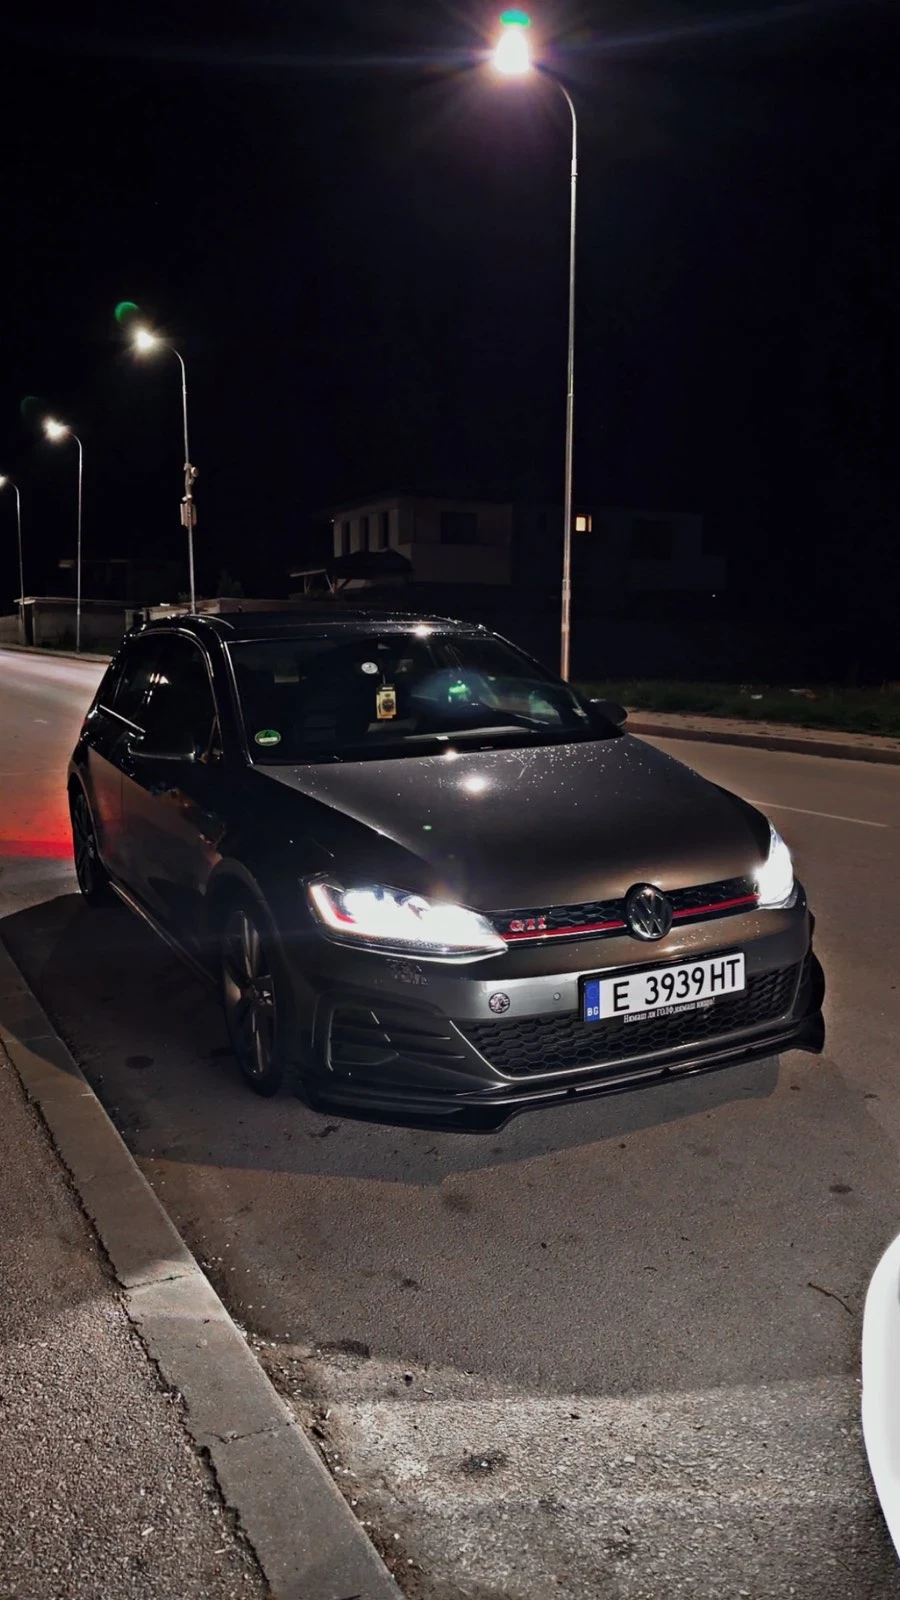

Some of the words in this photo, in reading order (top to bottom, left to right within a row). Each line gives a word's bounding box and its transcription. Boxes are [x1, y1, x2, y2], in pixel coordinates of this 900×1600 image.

[509, 915, 547, 932] GTI
[613, 981, 630, 1012] E
[645, 967, 705, 1005] 3939
[710, 958, 740, 992] HT
[587, 1006, 599, 1017] BG
